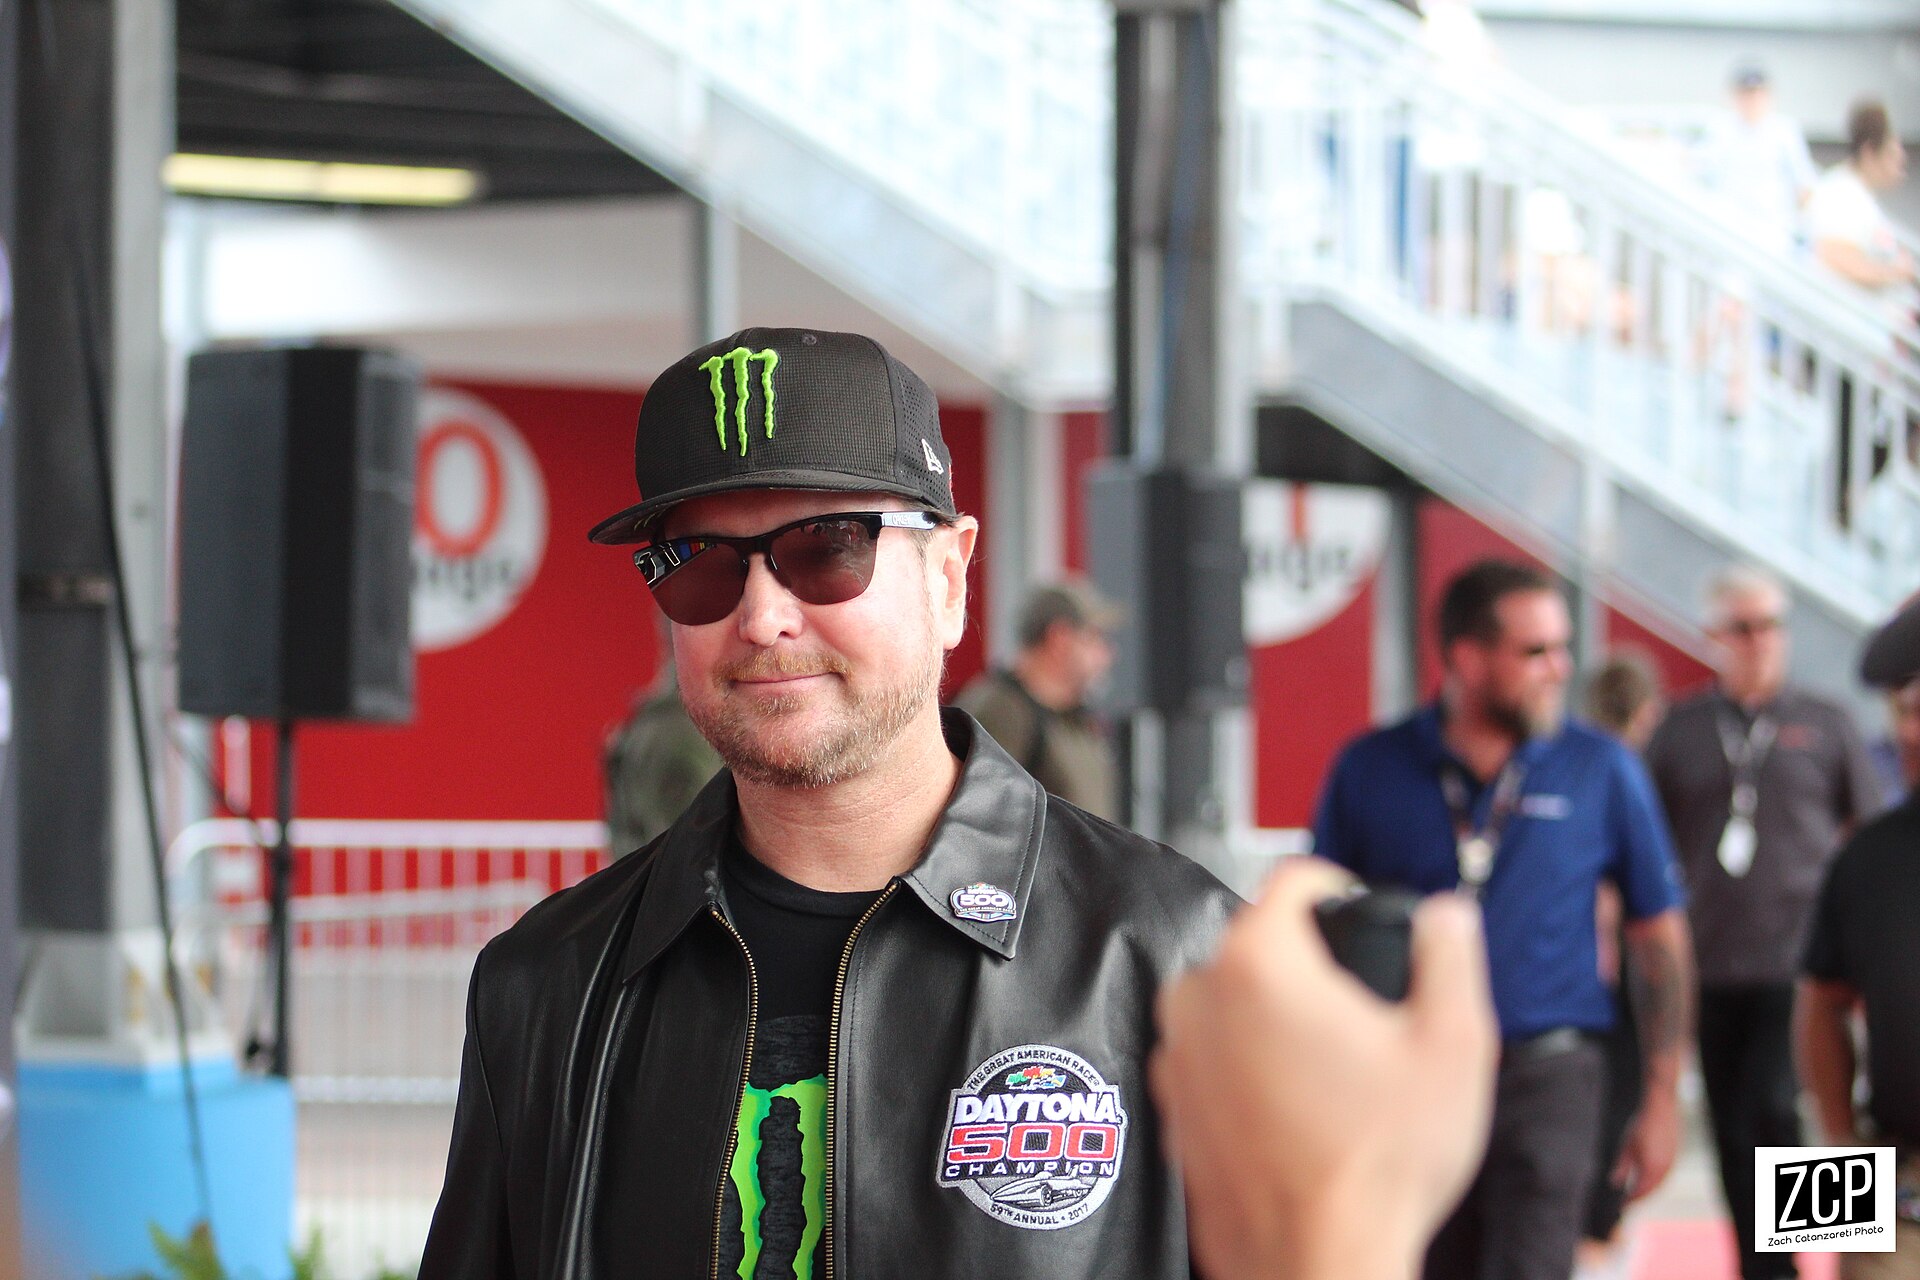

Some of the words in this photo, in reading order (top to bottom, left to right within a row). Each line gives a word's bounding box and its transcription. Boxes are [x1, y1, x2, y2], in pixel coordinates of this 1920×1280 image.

[960, 894, 1009, 907] 500
[967, 1072, 986, 1090] THE
[985, 1053, 1015, 1075] GREAT
[1017, 1049, 1071, 1065] AMERICAN
[953, 1092, 1119, 1124] DAYTONA
[947, 1123, 1119, 1163] 500
[945, 1162, 1113, 1177] CHAMPION
[1013, 1212, 1060, 1226] ANNUAL
[1068, 1202, 1089, 1221] 2017
